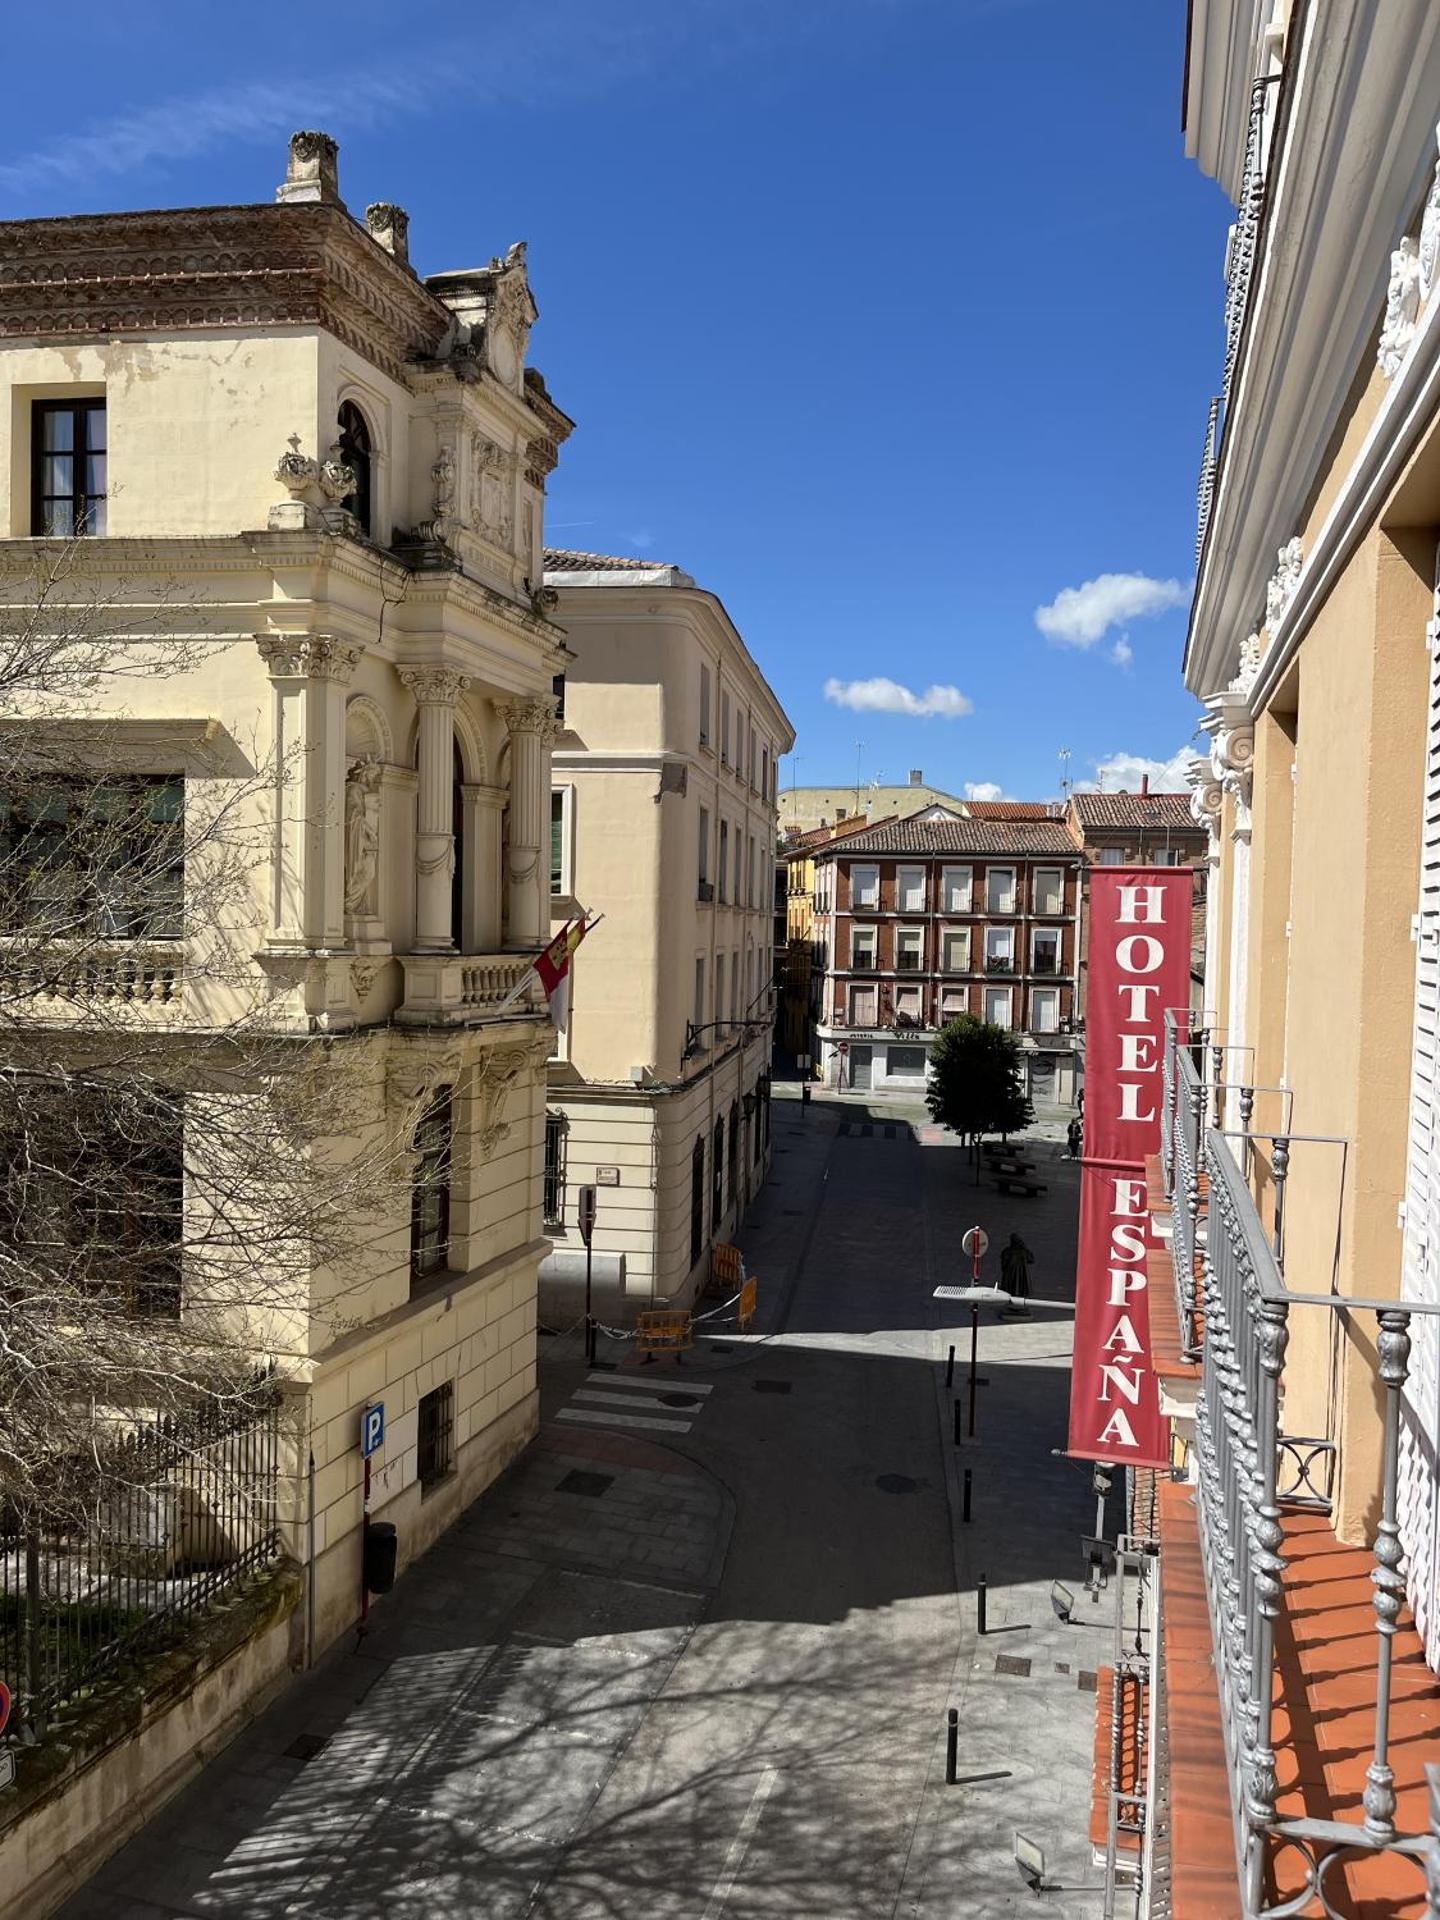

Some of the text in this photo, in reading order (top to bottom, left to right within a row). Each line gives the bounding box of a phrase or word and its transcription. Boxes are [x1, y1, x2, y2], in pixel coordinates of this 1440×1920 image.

[1115, 886, 1168, 1123] HOTEL
[368, 1411, 381, 1450] P
[1097, 1178, 1149, 1447] ESPAÑA
